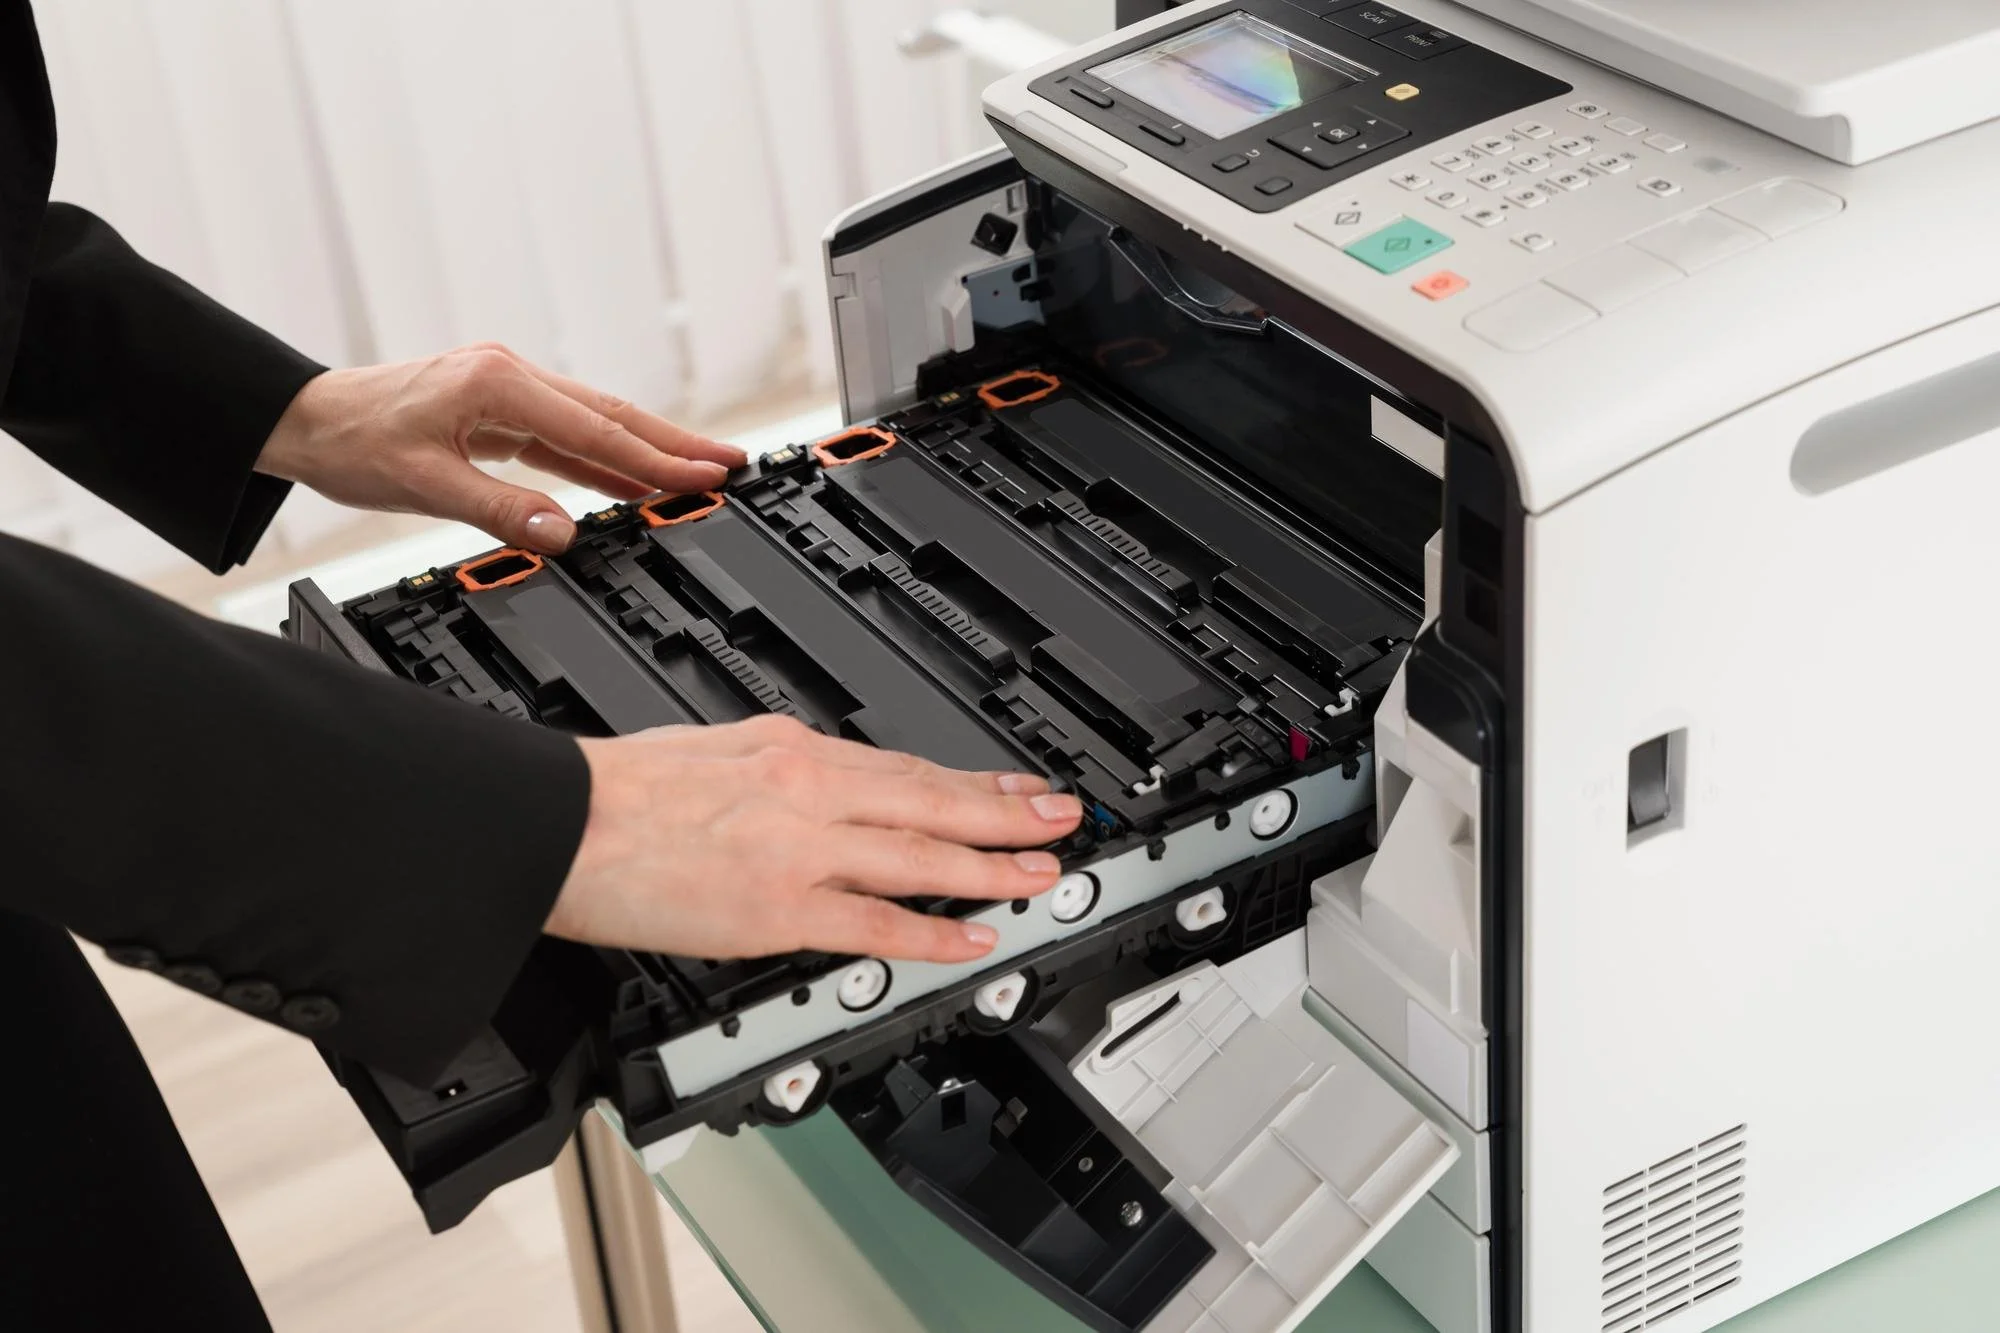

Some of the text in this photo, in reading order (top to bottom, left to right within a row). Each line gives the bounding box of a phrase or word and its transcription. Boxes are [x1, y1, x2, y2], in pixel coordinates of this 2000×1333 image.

[1359, 11, 1387, 25] SCAN
[1330, 128, 1348, 138] OK
[1561, 142, 1579, 150] 2
[1520, 157, 1538, 166] 5
[1600, 158, 1618, 167] 3
